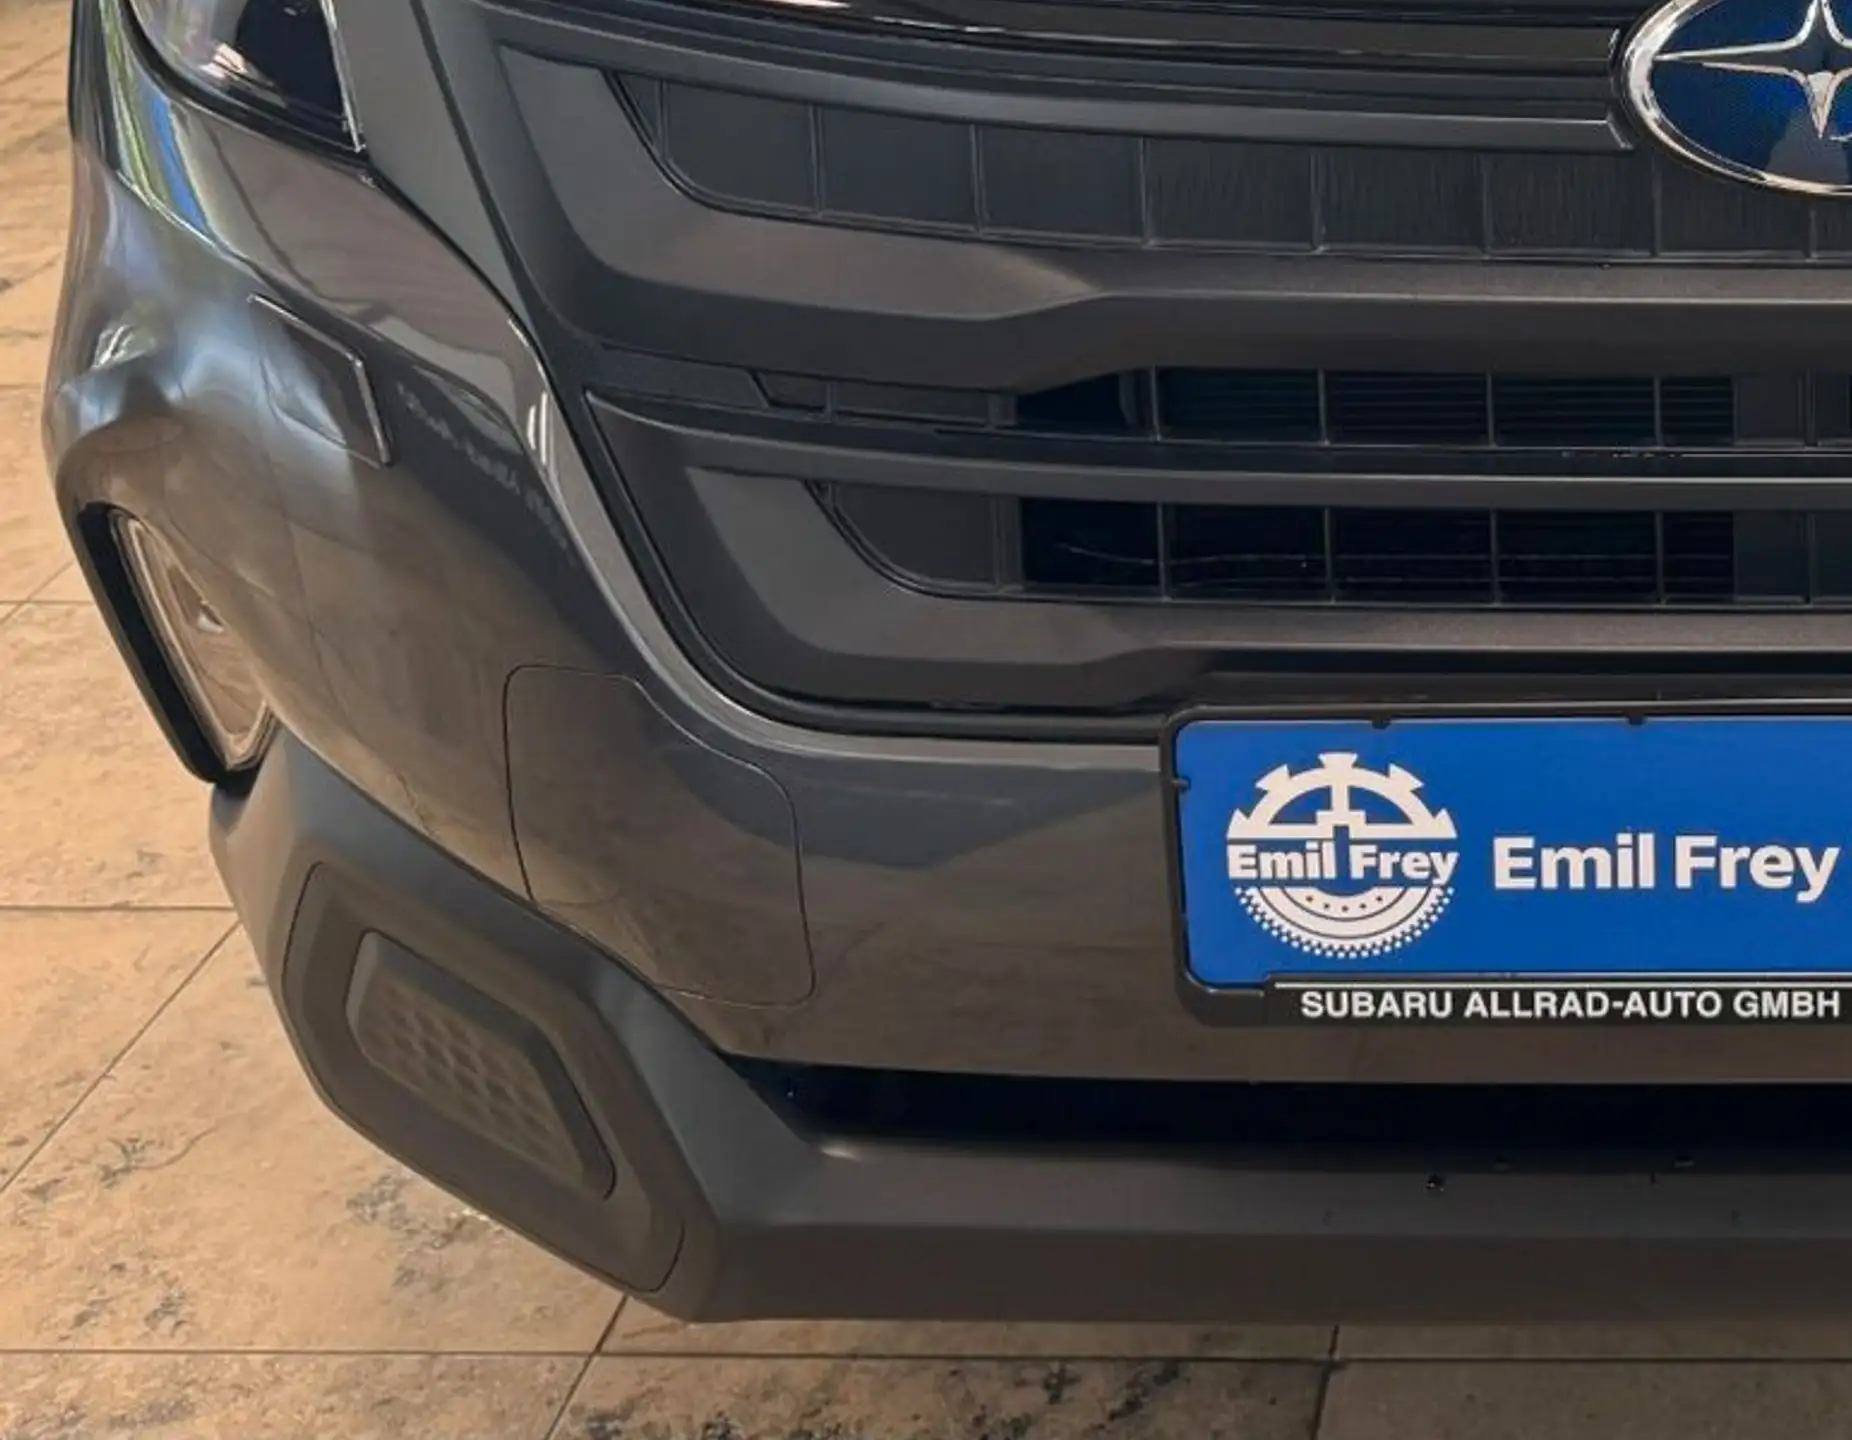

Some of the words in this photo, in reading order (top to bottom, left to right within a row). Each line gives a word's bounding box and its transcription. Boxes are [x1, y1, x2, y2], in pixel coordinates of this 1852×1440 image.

[1227, 840, 1337, 880] Emil
[1349, 844, 1459, 886] Frey
[1493, 833, 1655, 889] Emil
[1675, 835, 1840, 903] Frey
[1301, 990, 1453, 1018] SUBARU
[1464, 990, 1722, 1018] ALLRAD-AUTO
[1733, 990, 1841, 1018] GMBH
